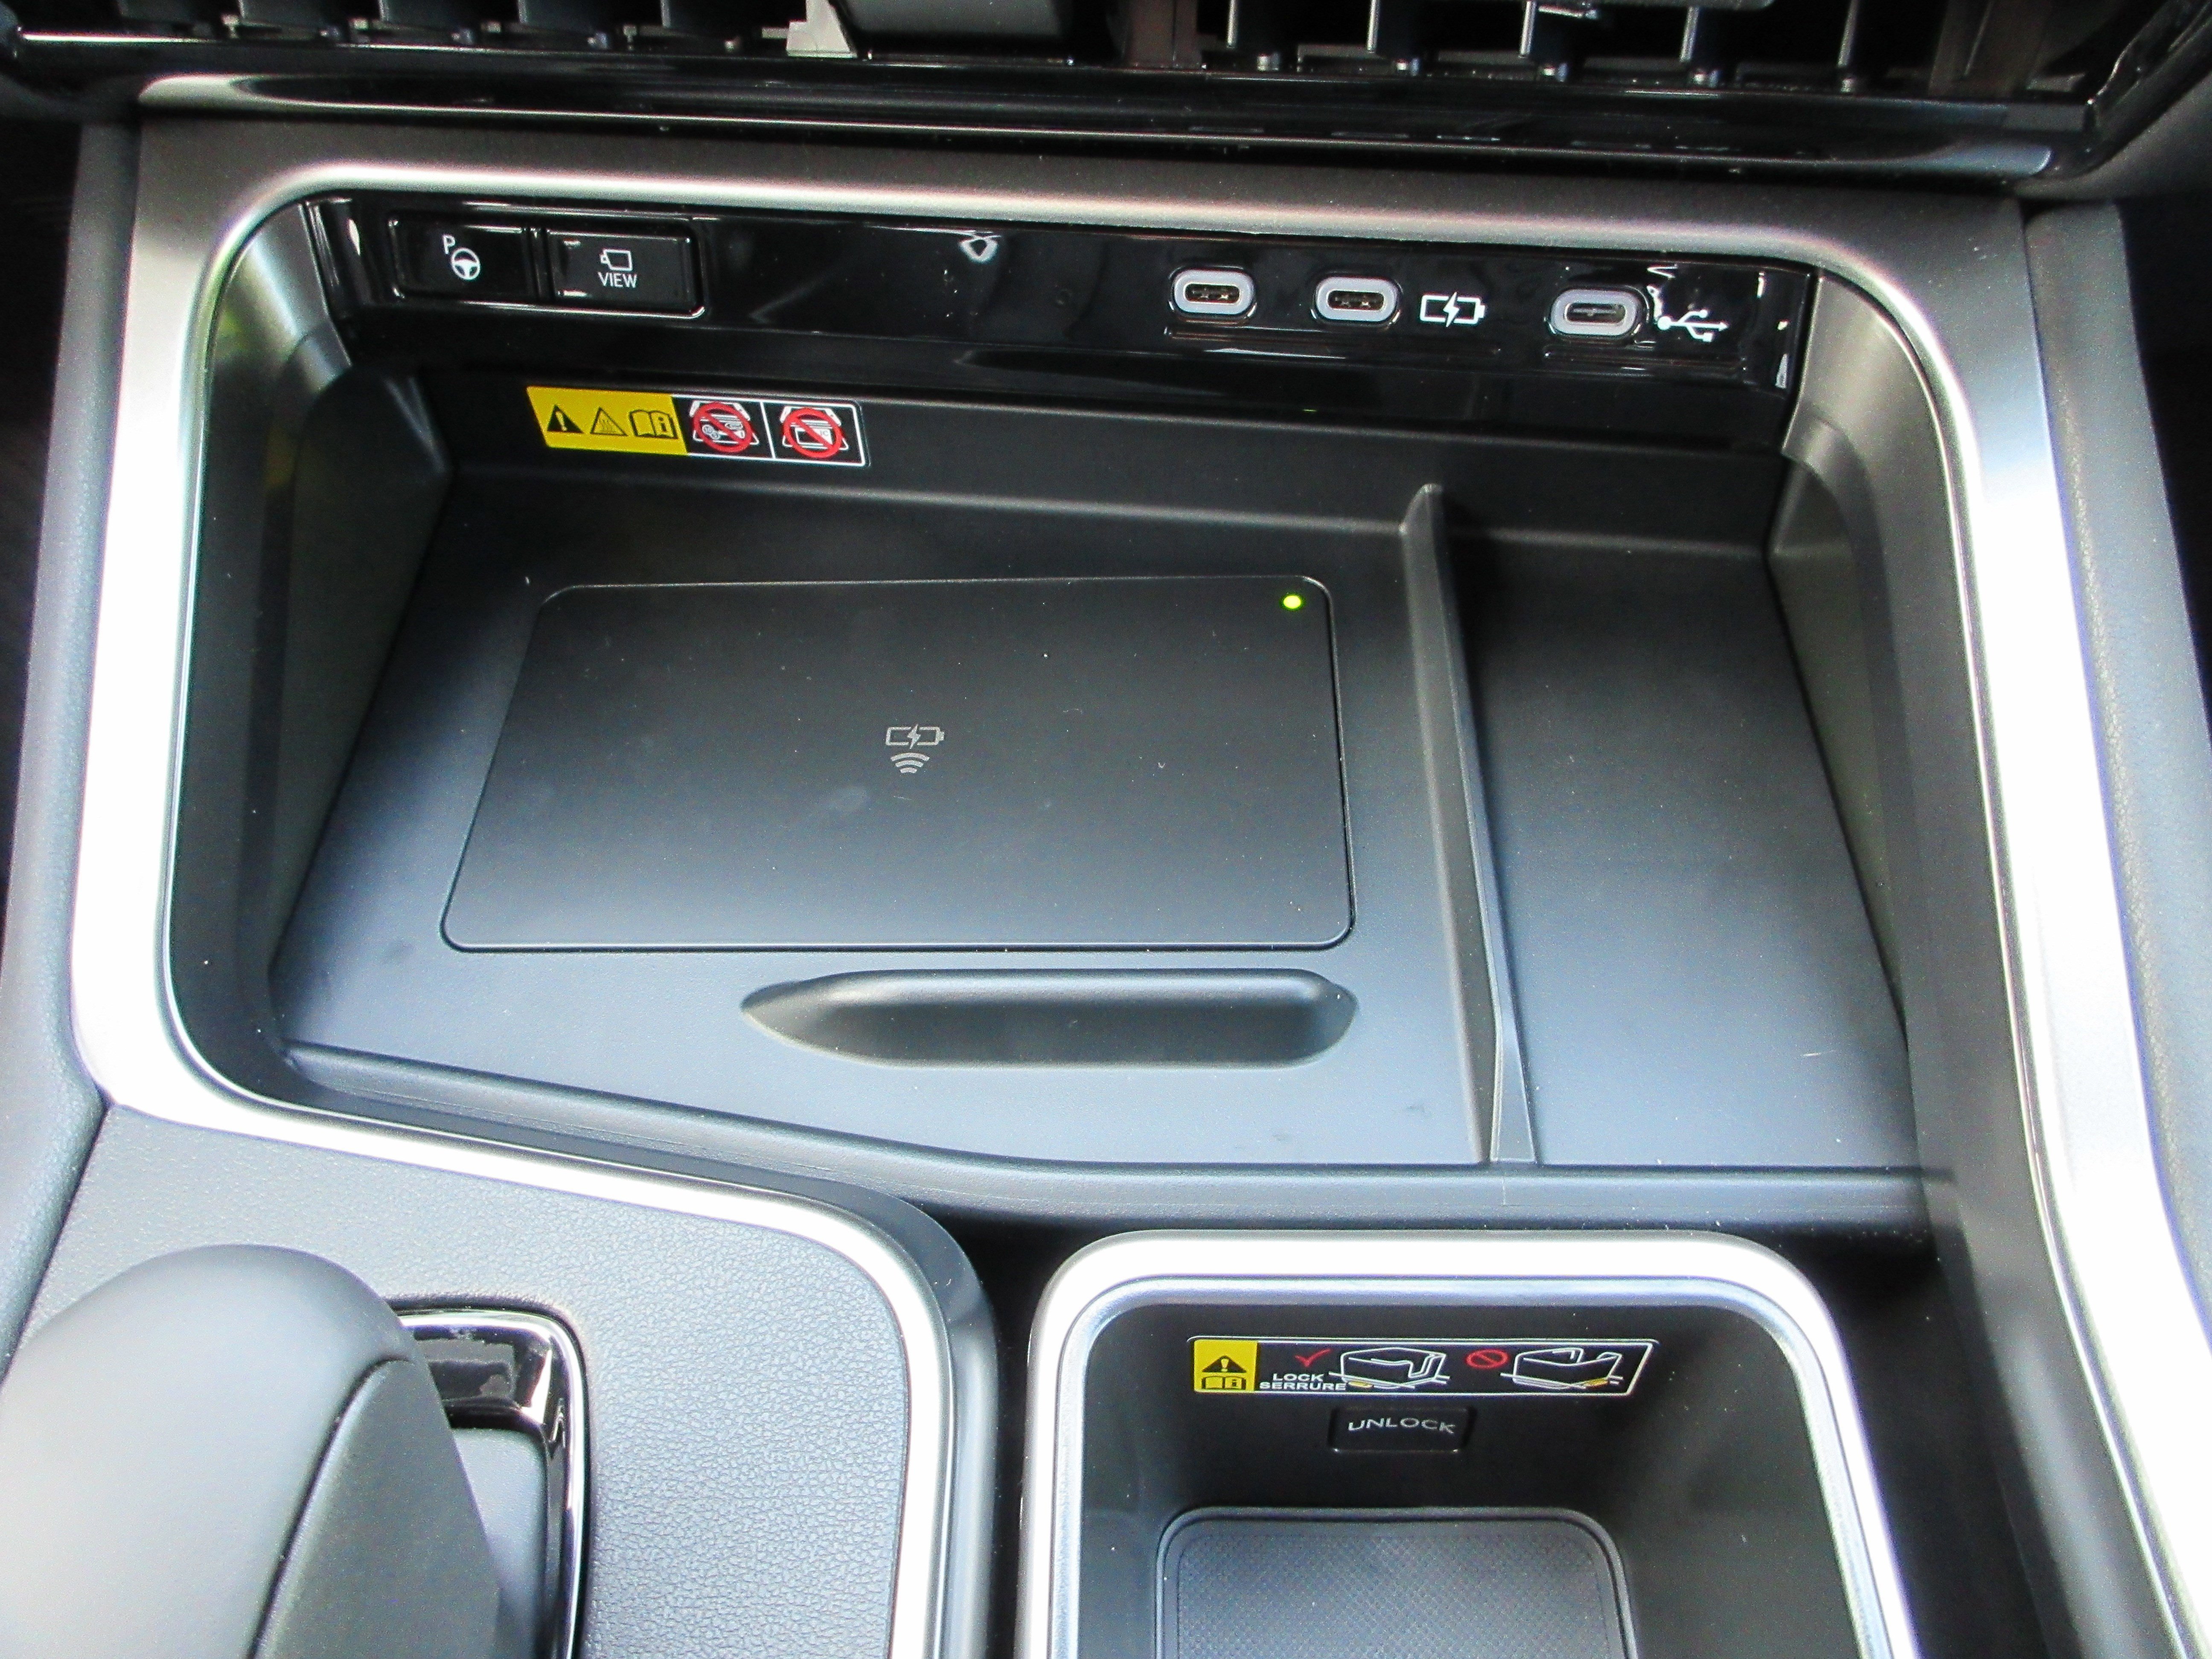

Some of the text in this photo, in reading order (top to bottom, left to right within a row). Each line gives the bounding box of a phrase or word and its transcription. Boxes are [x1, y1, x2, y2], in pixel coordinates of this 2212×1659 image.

[442, 234, 456, 255] P
[597, 271, 637, 288] VIEW
[1259, 1381, 1347, 1391] SERRURE
[1272, 1373, 1324, 1382] LOCK
[1348, 1417, 1455, 1434] UNLOCK
